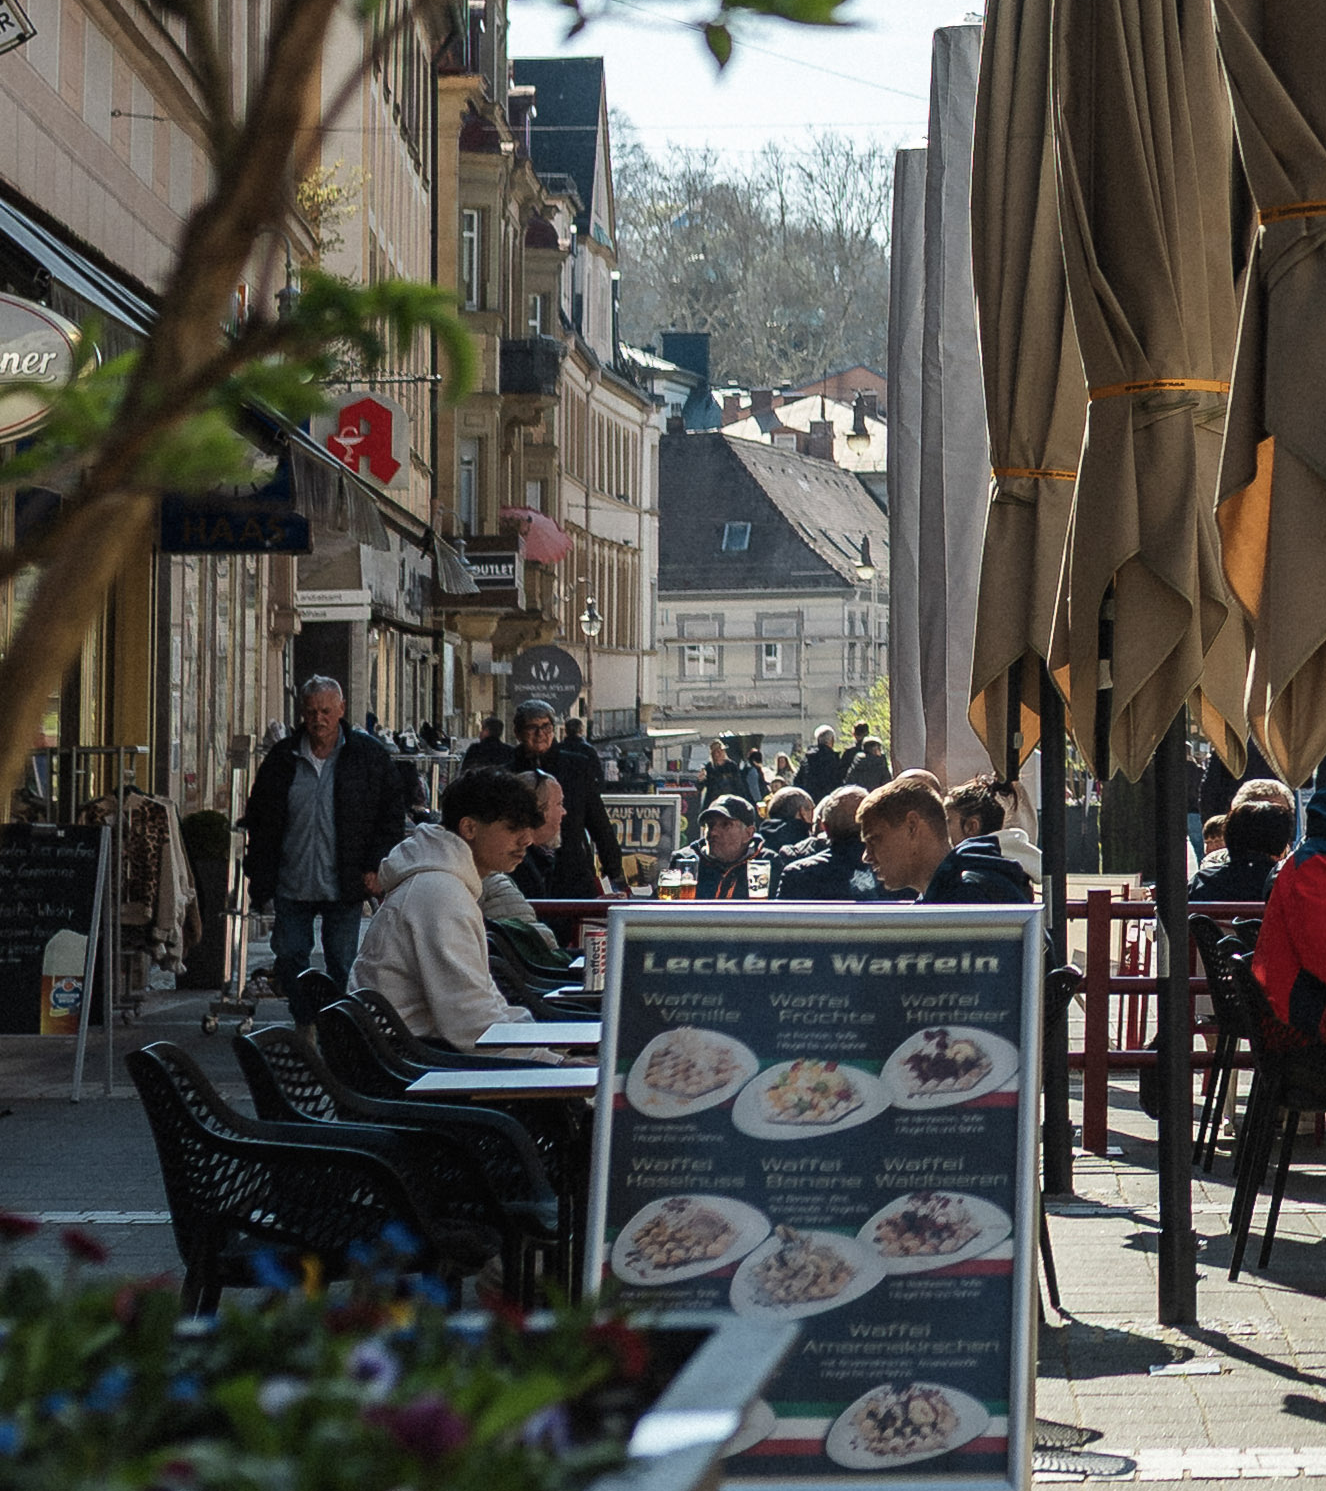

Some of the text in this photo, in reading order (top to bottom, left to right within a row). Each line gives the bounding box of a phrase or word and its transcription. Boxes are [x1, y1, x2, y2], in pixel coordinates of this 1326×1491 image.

[183, 517, 287, 544] HAAS
[473, 564, 514, 576] OUTLET
[636, 806, 661, 820] VON
[642, 952, 1000, 975] Leckere Waffeln
